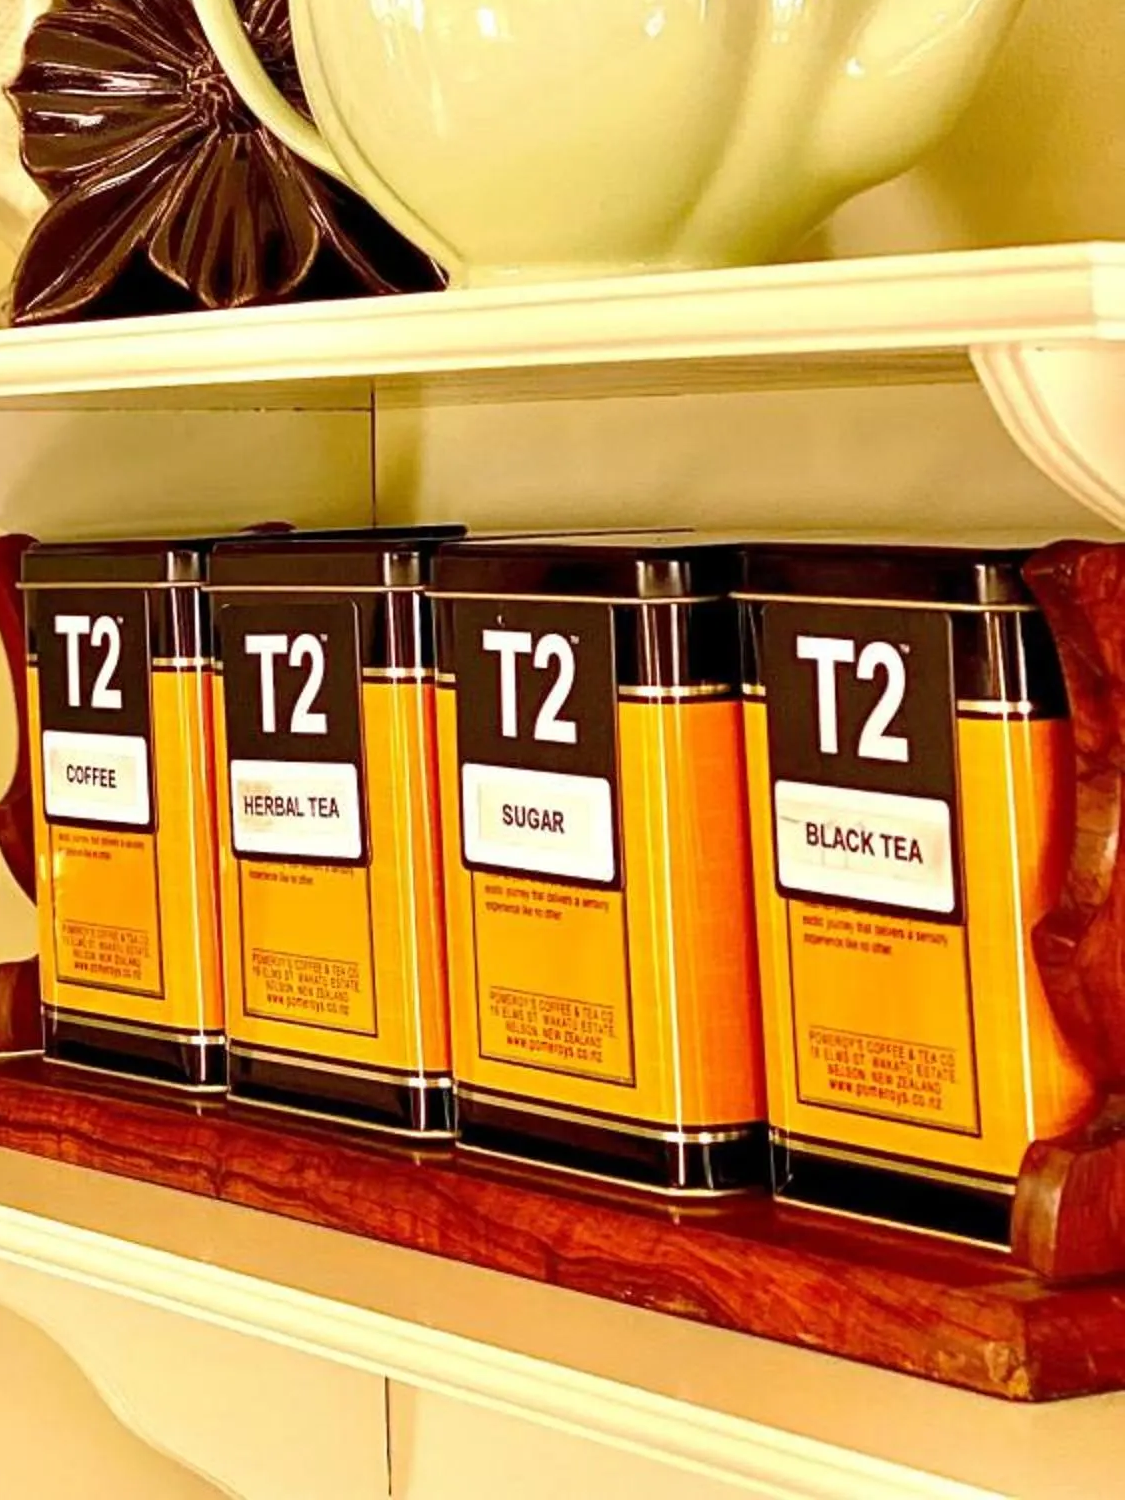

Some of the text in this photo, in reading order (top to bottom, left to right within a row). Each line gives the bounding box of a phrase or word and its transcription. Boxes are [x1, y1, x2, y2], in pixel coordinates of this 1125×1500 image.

[54, 615, 123, 709] T2
[245, 633, 328, 734] T2
[483, 630, 578, 744] T2
[796, 635, 910, 763] T2
[66, 763, 117, 789] COFFEE
[244, 795, 340, 818] HERBAL TEA
[502, 804, 565, 834] SUGAR
[806, 821, 923, 864] BLACK TEA
